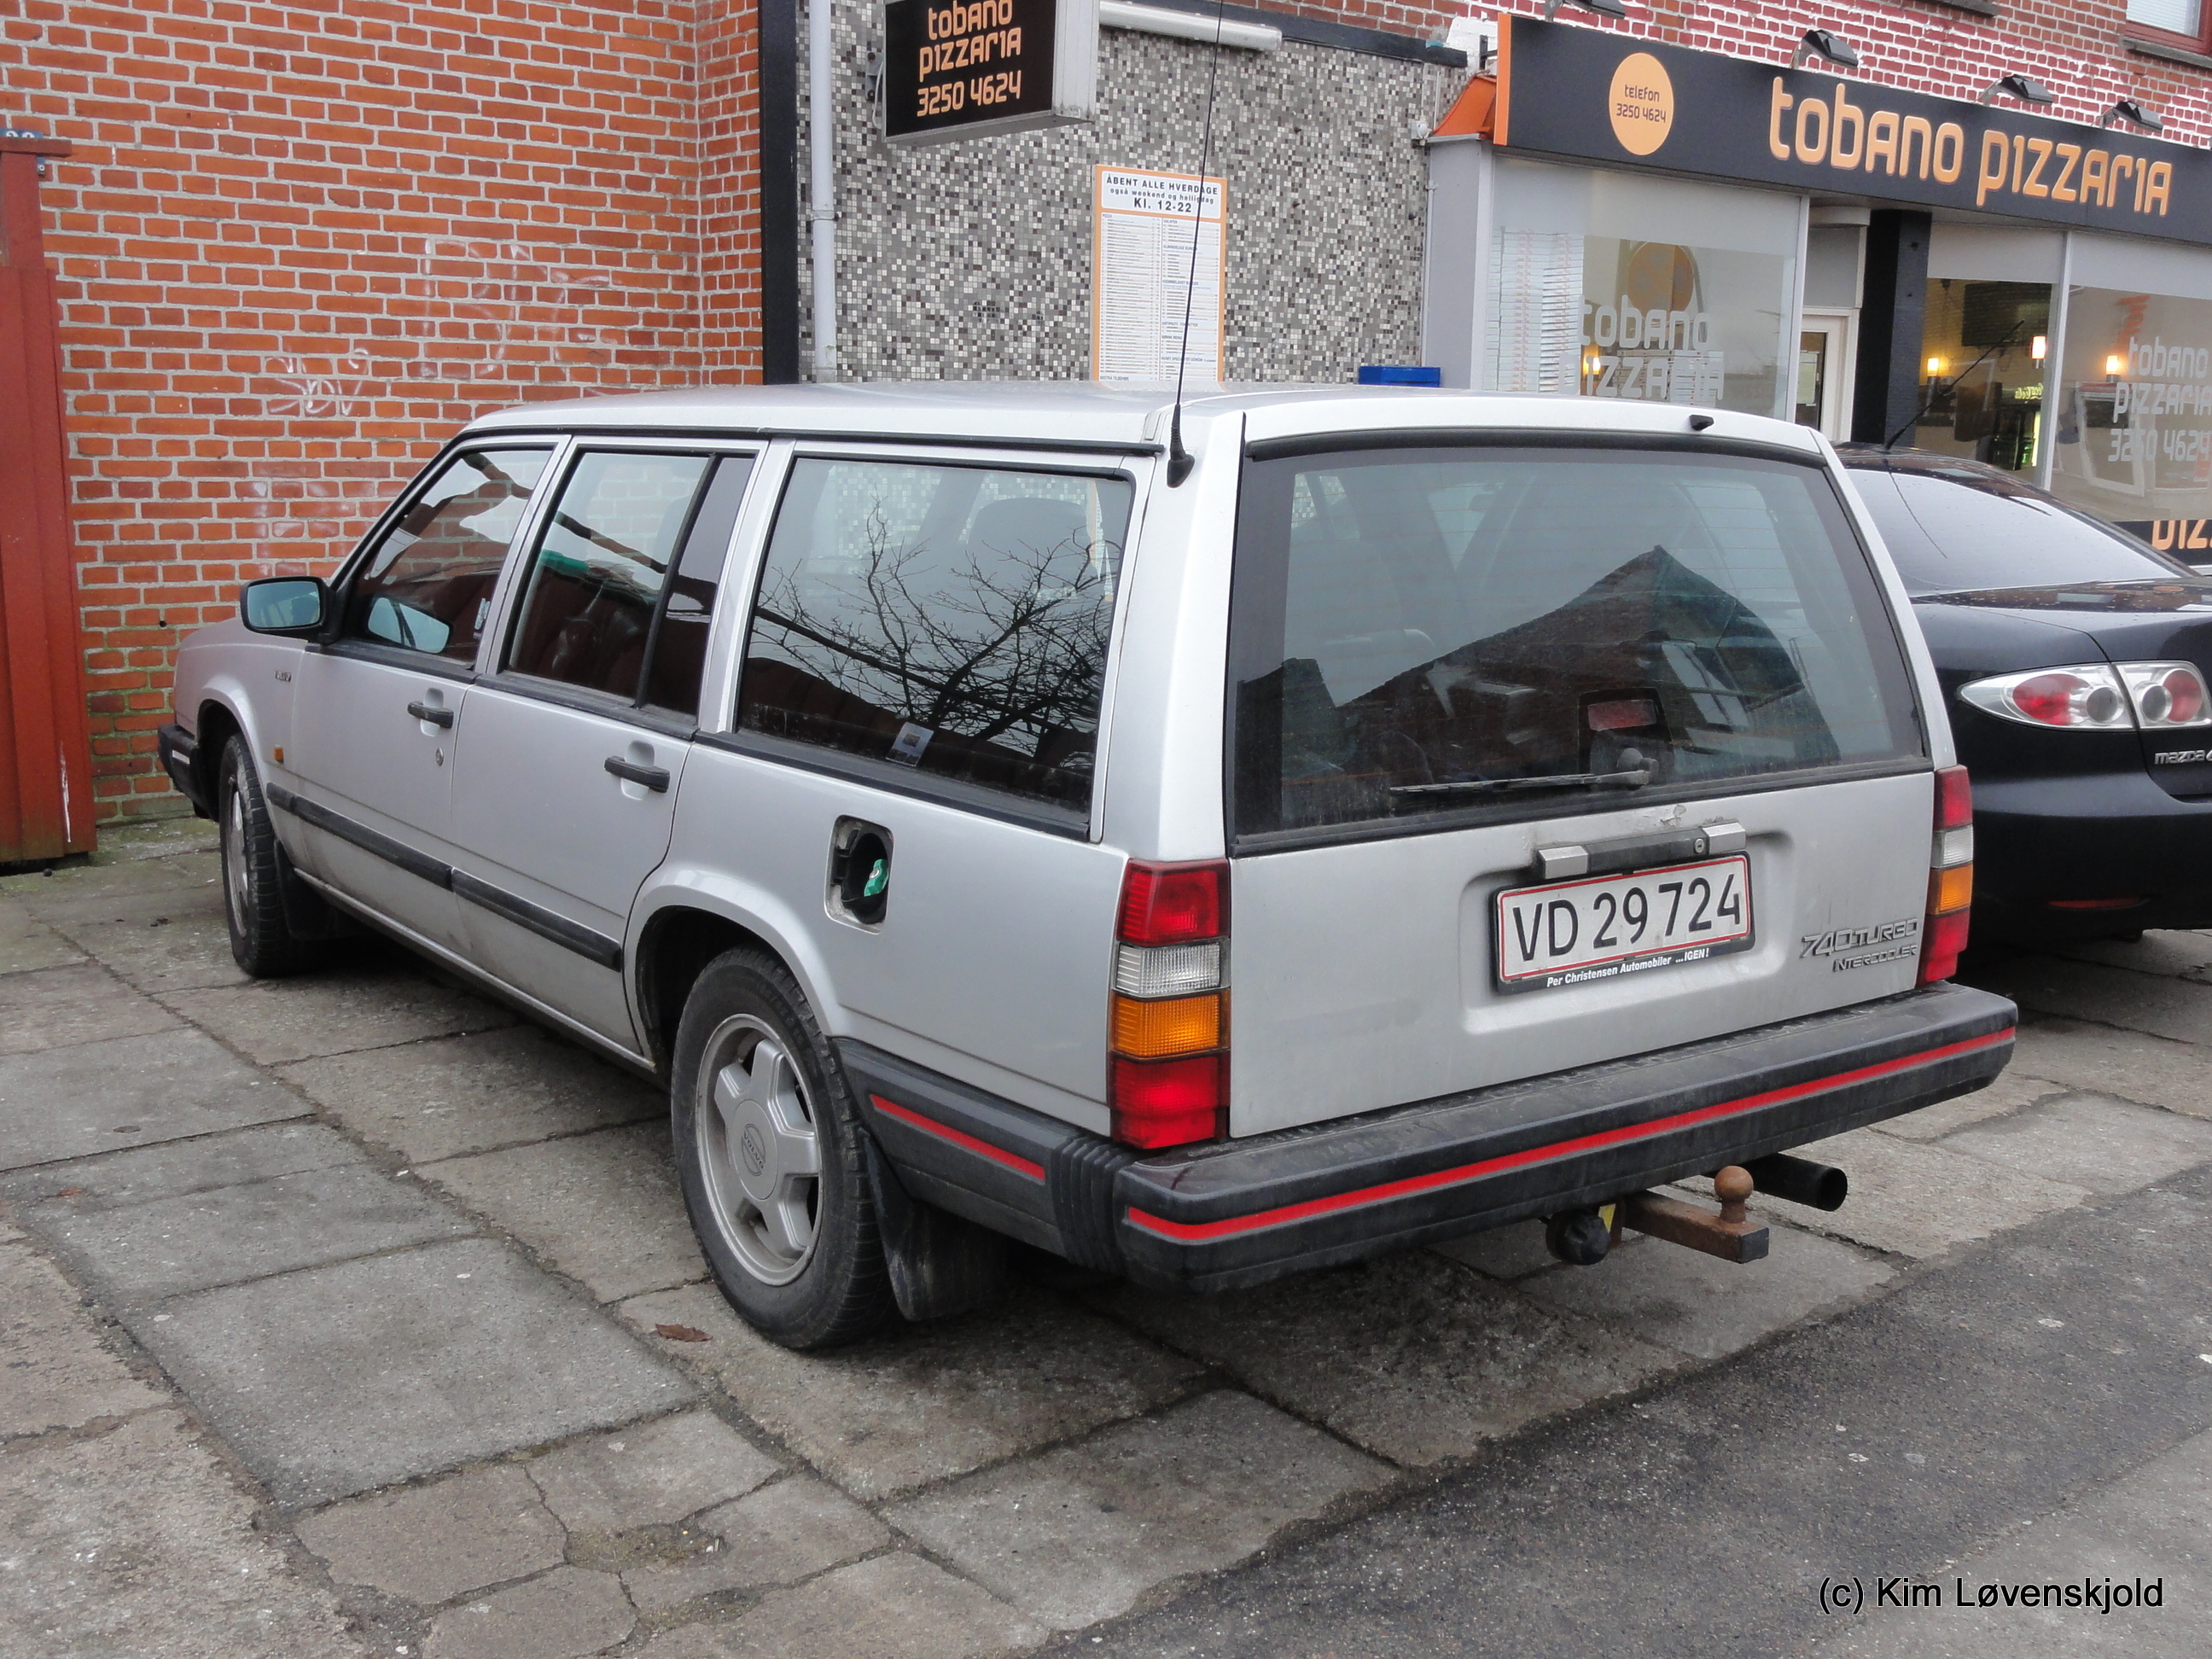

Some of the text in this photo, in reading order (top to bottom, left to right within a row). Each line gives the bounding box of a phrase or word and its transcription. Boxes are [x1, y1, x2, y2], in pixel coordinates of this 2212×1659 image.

[917, 69, 1022, 117] 3250 4624
[1624, 84, 1660, 102] telefon
[1616, 102, 1667, 124] 3250 4624
[1106, 173, 1219, 195] ÅBENT ALLE HVERDAGE
[1109, 187, 1128, 196] også
[1132, 189, 1165, 199] weekend
[1167, 193, 1177, 201] og
[1157, 200, 1192, 212] 12-22
[2163, 429, 2212, 462] 4624
[1511, 873, 1741, 962] VD 29 724
[1546, 976, 1563, 988] Per
[1564, 966, 1618, 984] Christensen
[1619, 955, 1672, 975] Automobiler
[1832, 945, 1918, 972] INTERCOOLER
[744, 1130, 765, 1169] VOLVO
